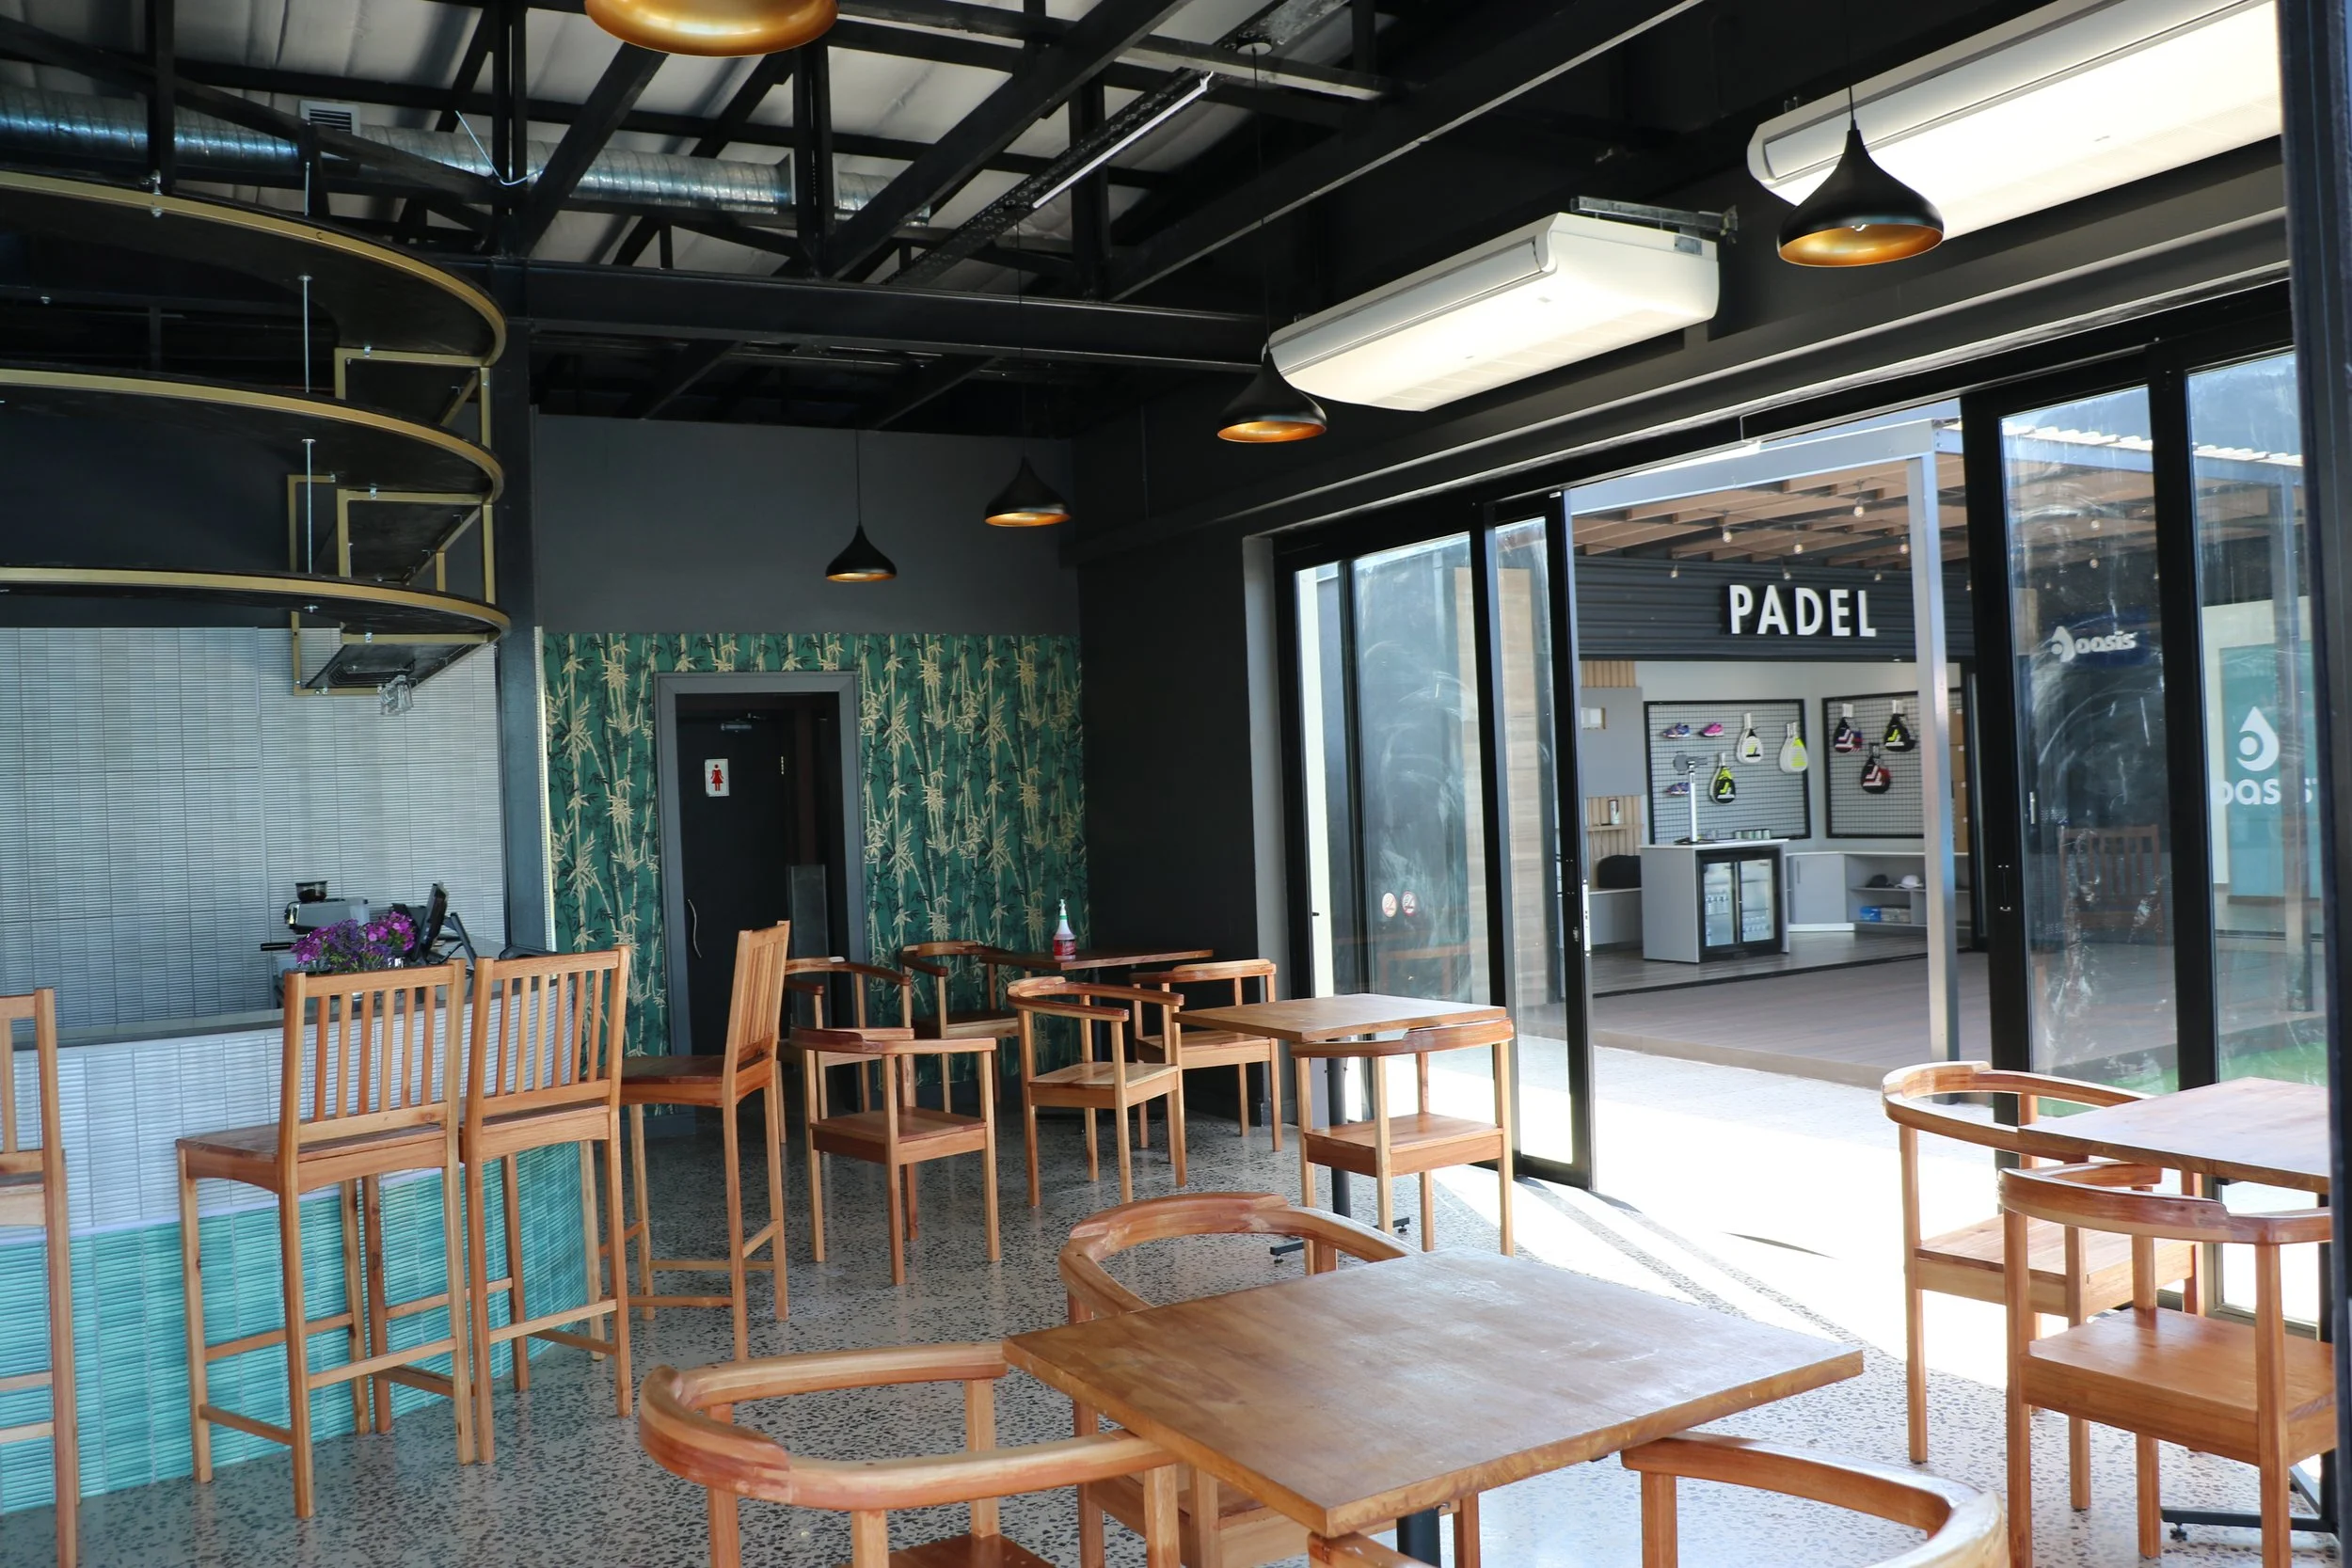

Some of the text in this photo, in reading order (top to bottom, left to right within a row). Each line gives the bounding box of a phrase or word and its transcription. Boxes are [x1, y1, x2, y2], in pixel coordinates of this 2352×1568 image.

[1729, 585, 1877, 637] PADEL
[2075, 631, 2137, 654] oasis
[2210, 778, 2313, 805] oas
